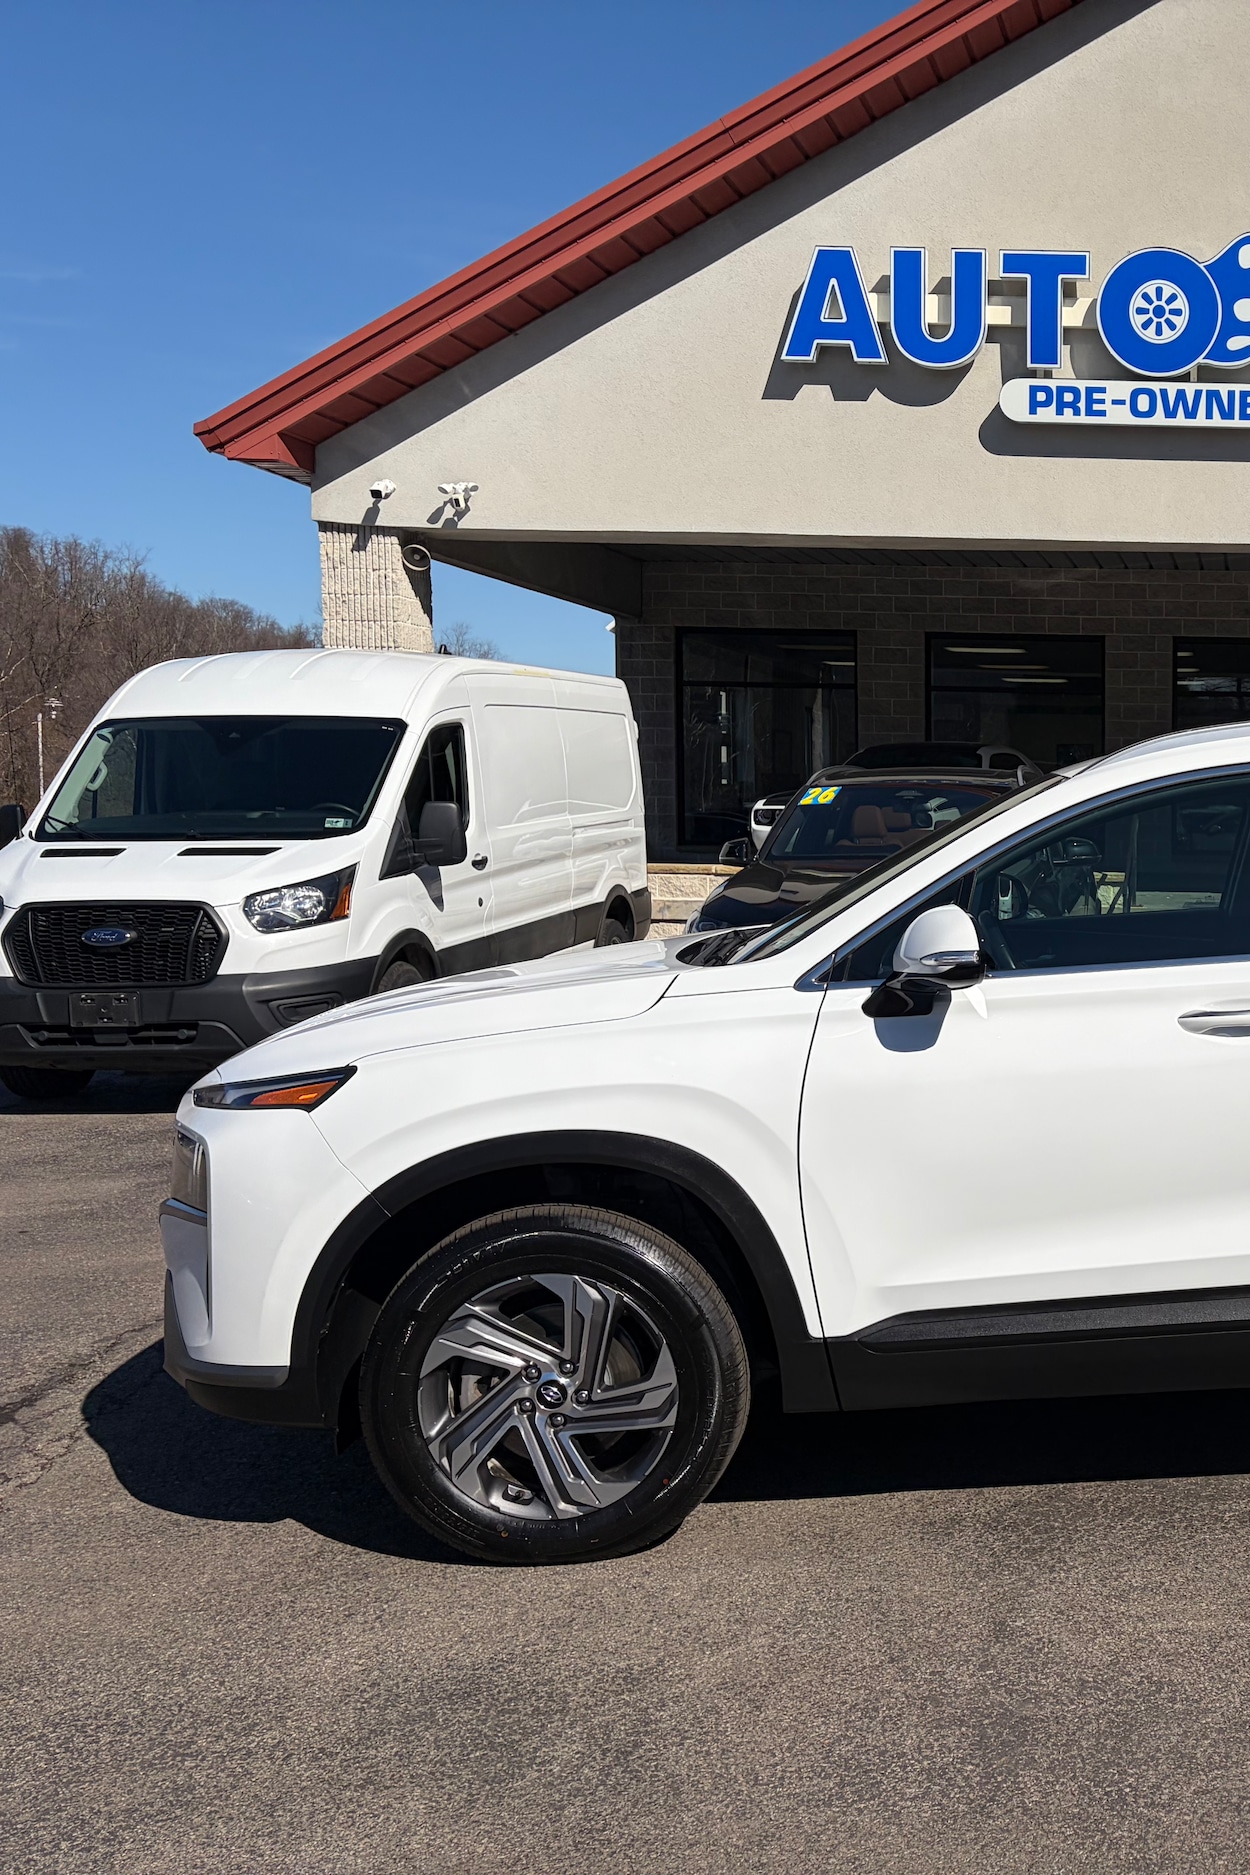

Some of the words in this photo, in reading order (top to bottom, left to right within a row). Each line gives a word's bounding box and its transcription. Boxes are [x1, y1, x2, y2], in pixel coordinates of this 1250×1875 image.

[780, 245, 1222, 377] AUTO
[800, 786, 838, 805] 26
[90, 930, 119, 942] Ford
